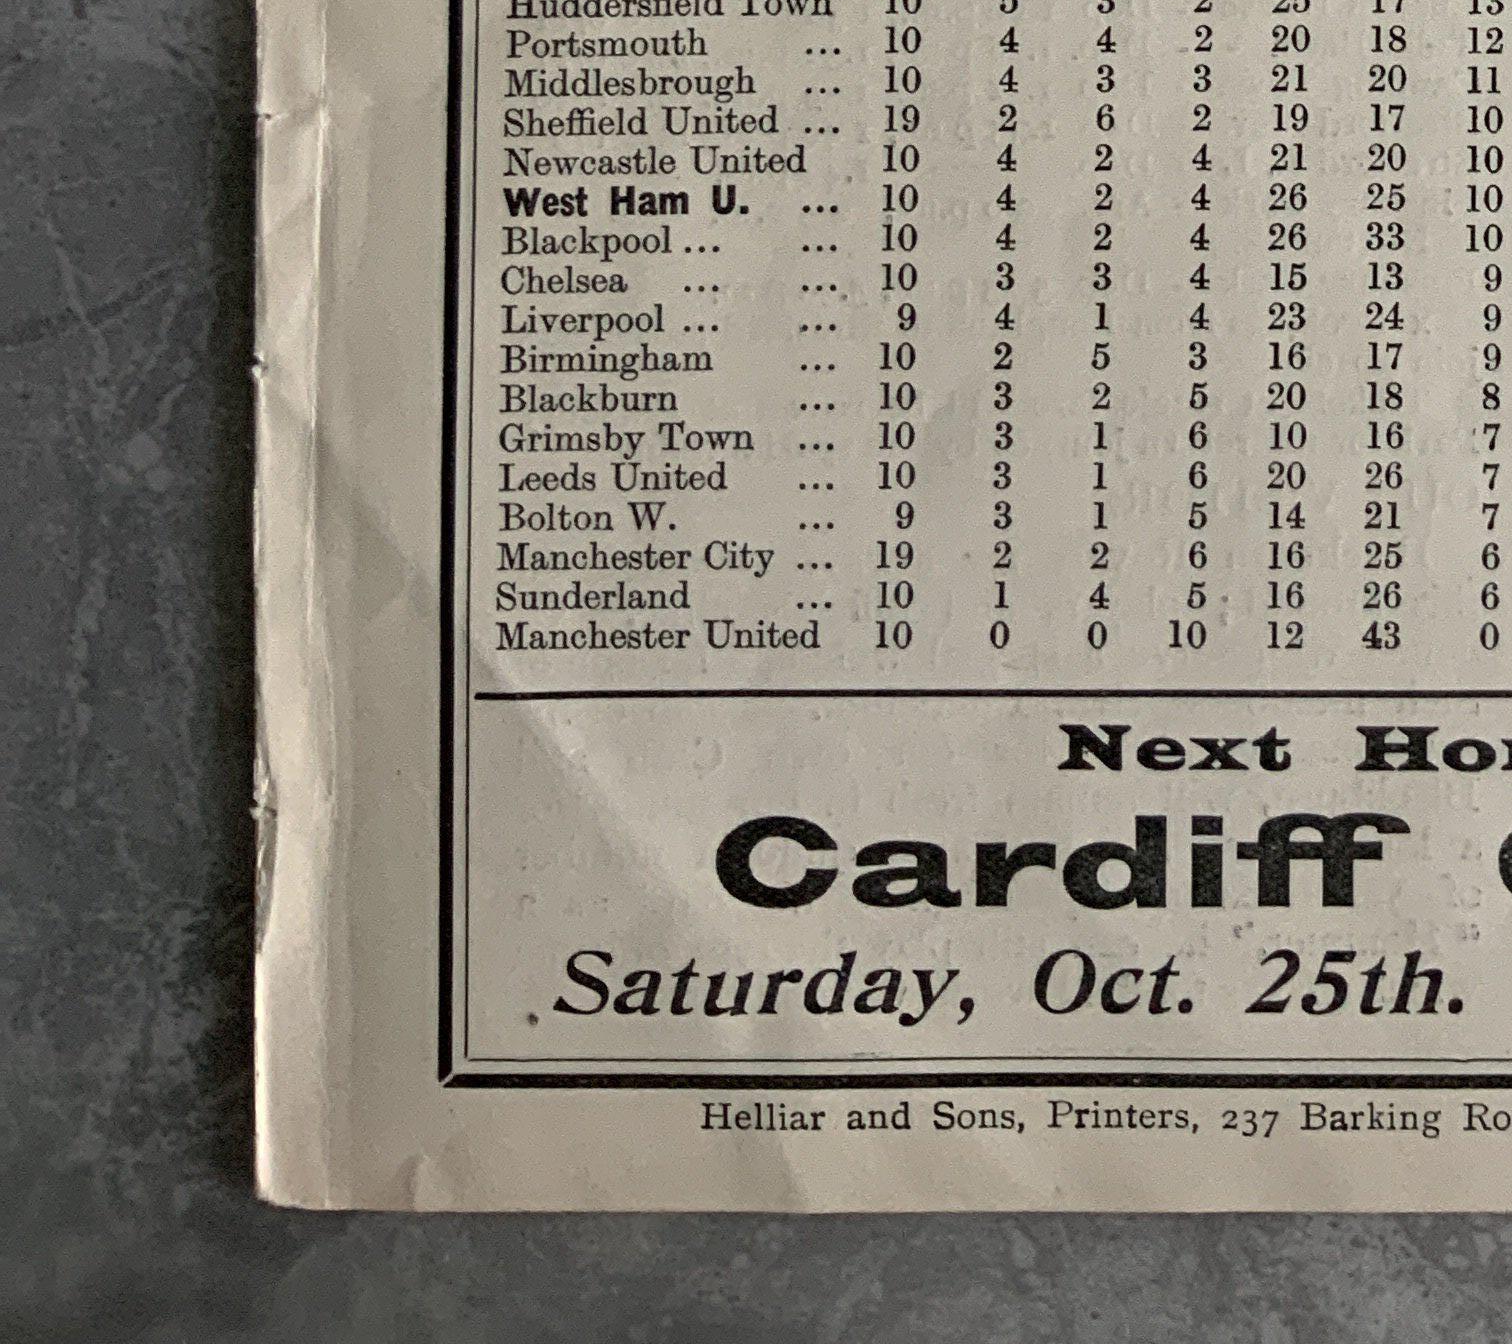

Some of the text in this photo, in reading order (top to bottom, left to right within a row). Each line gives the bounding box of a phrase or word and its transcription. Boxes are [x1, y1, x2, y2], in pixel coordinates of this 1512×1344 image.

[503, 65, 757, 104] Middlesbrough
[502, 184, 750, 218] West Ham U.
[495, 619, 821, 651] Manchester United
[1056, 723, 1292, 772] Next
[715, 812, 1412, 911] Cardiff
[552, 948, 1464, 1028] Saturday, Oct. 25th.
[700, 1102, 826, 1132] Helliar
[847, 1100, 912, 1131] and
[932, 1100, 1025, 1134] Sons,
[1047, 1100, 1199, 1134] Printers,
[1221, 1109, 1280, 1138] 237
[1300, 1101, 1442, 1139] Barking
